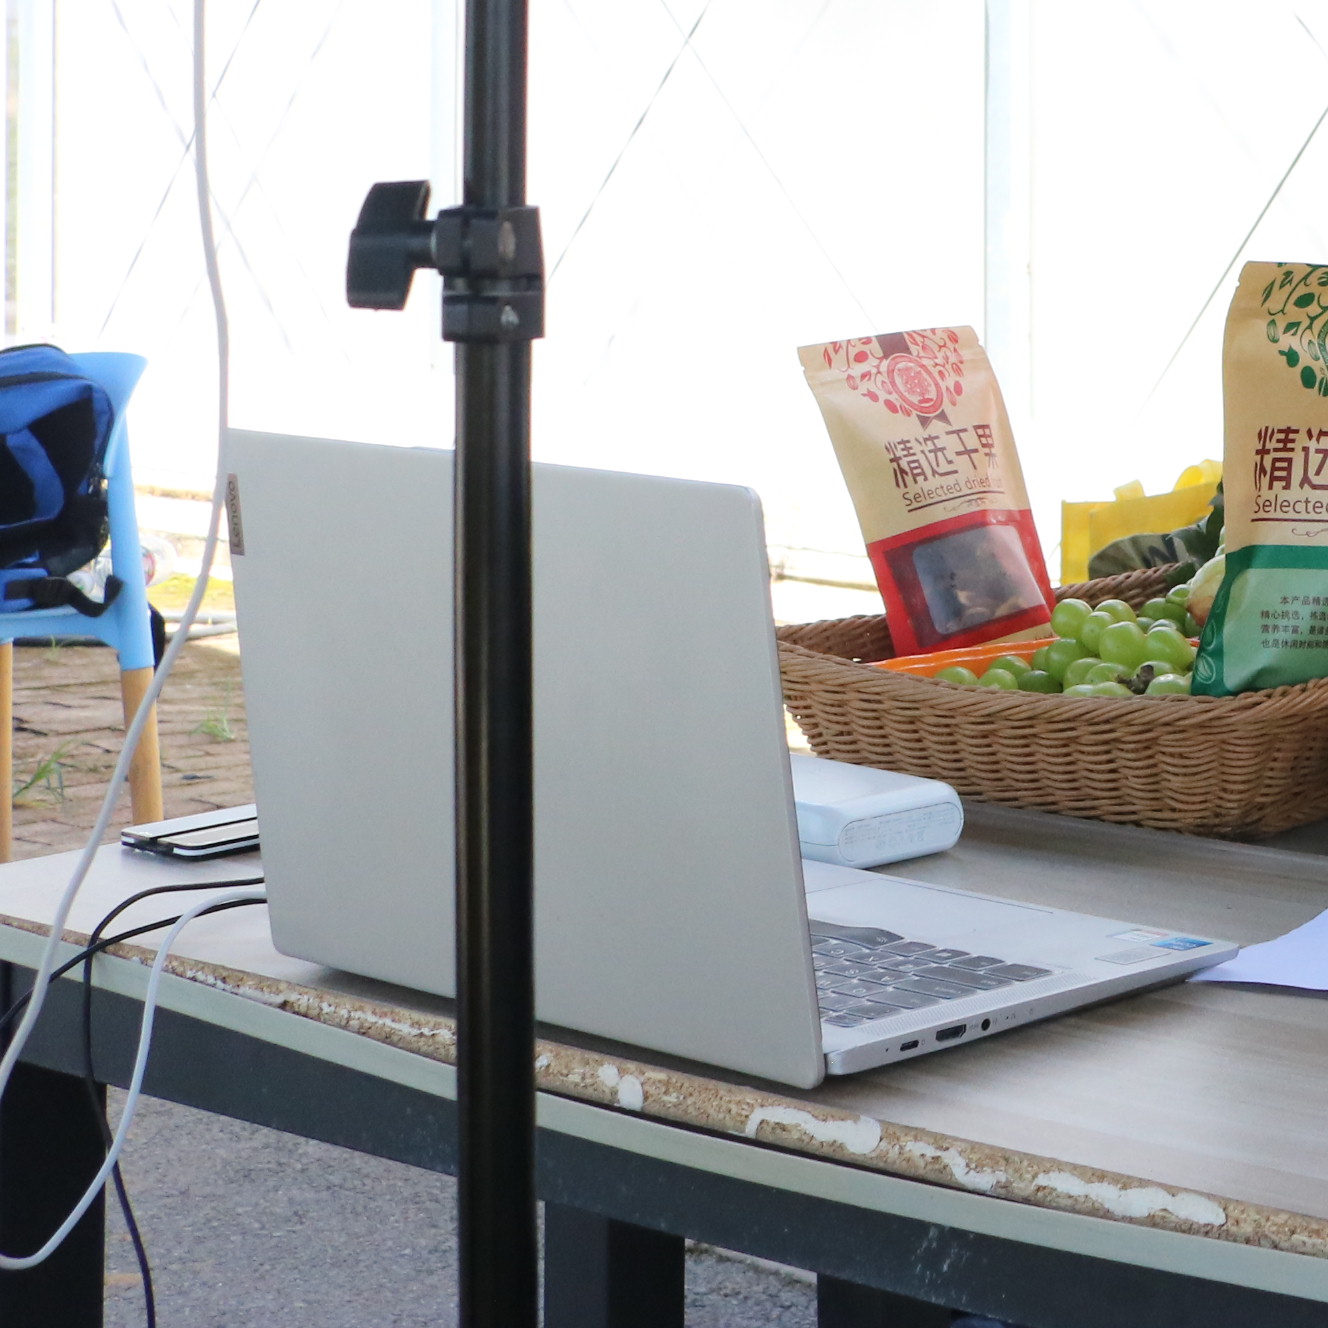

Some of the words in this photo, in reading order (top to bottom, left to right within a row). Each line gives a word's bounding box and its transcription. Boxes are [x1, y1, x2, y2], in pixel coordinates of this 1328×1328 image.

[884, 424, 999, 490] 精选干果
[227, 480, 242, 548] Lenovo
[902, 478, 962, 507] Selected
[965, 474, 991, 491] dried
